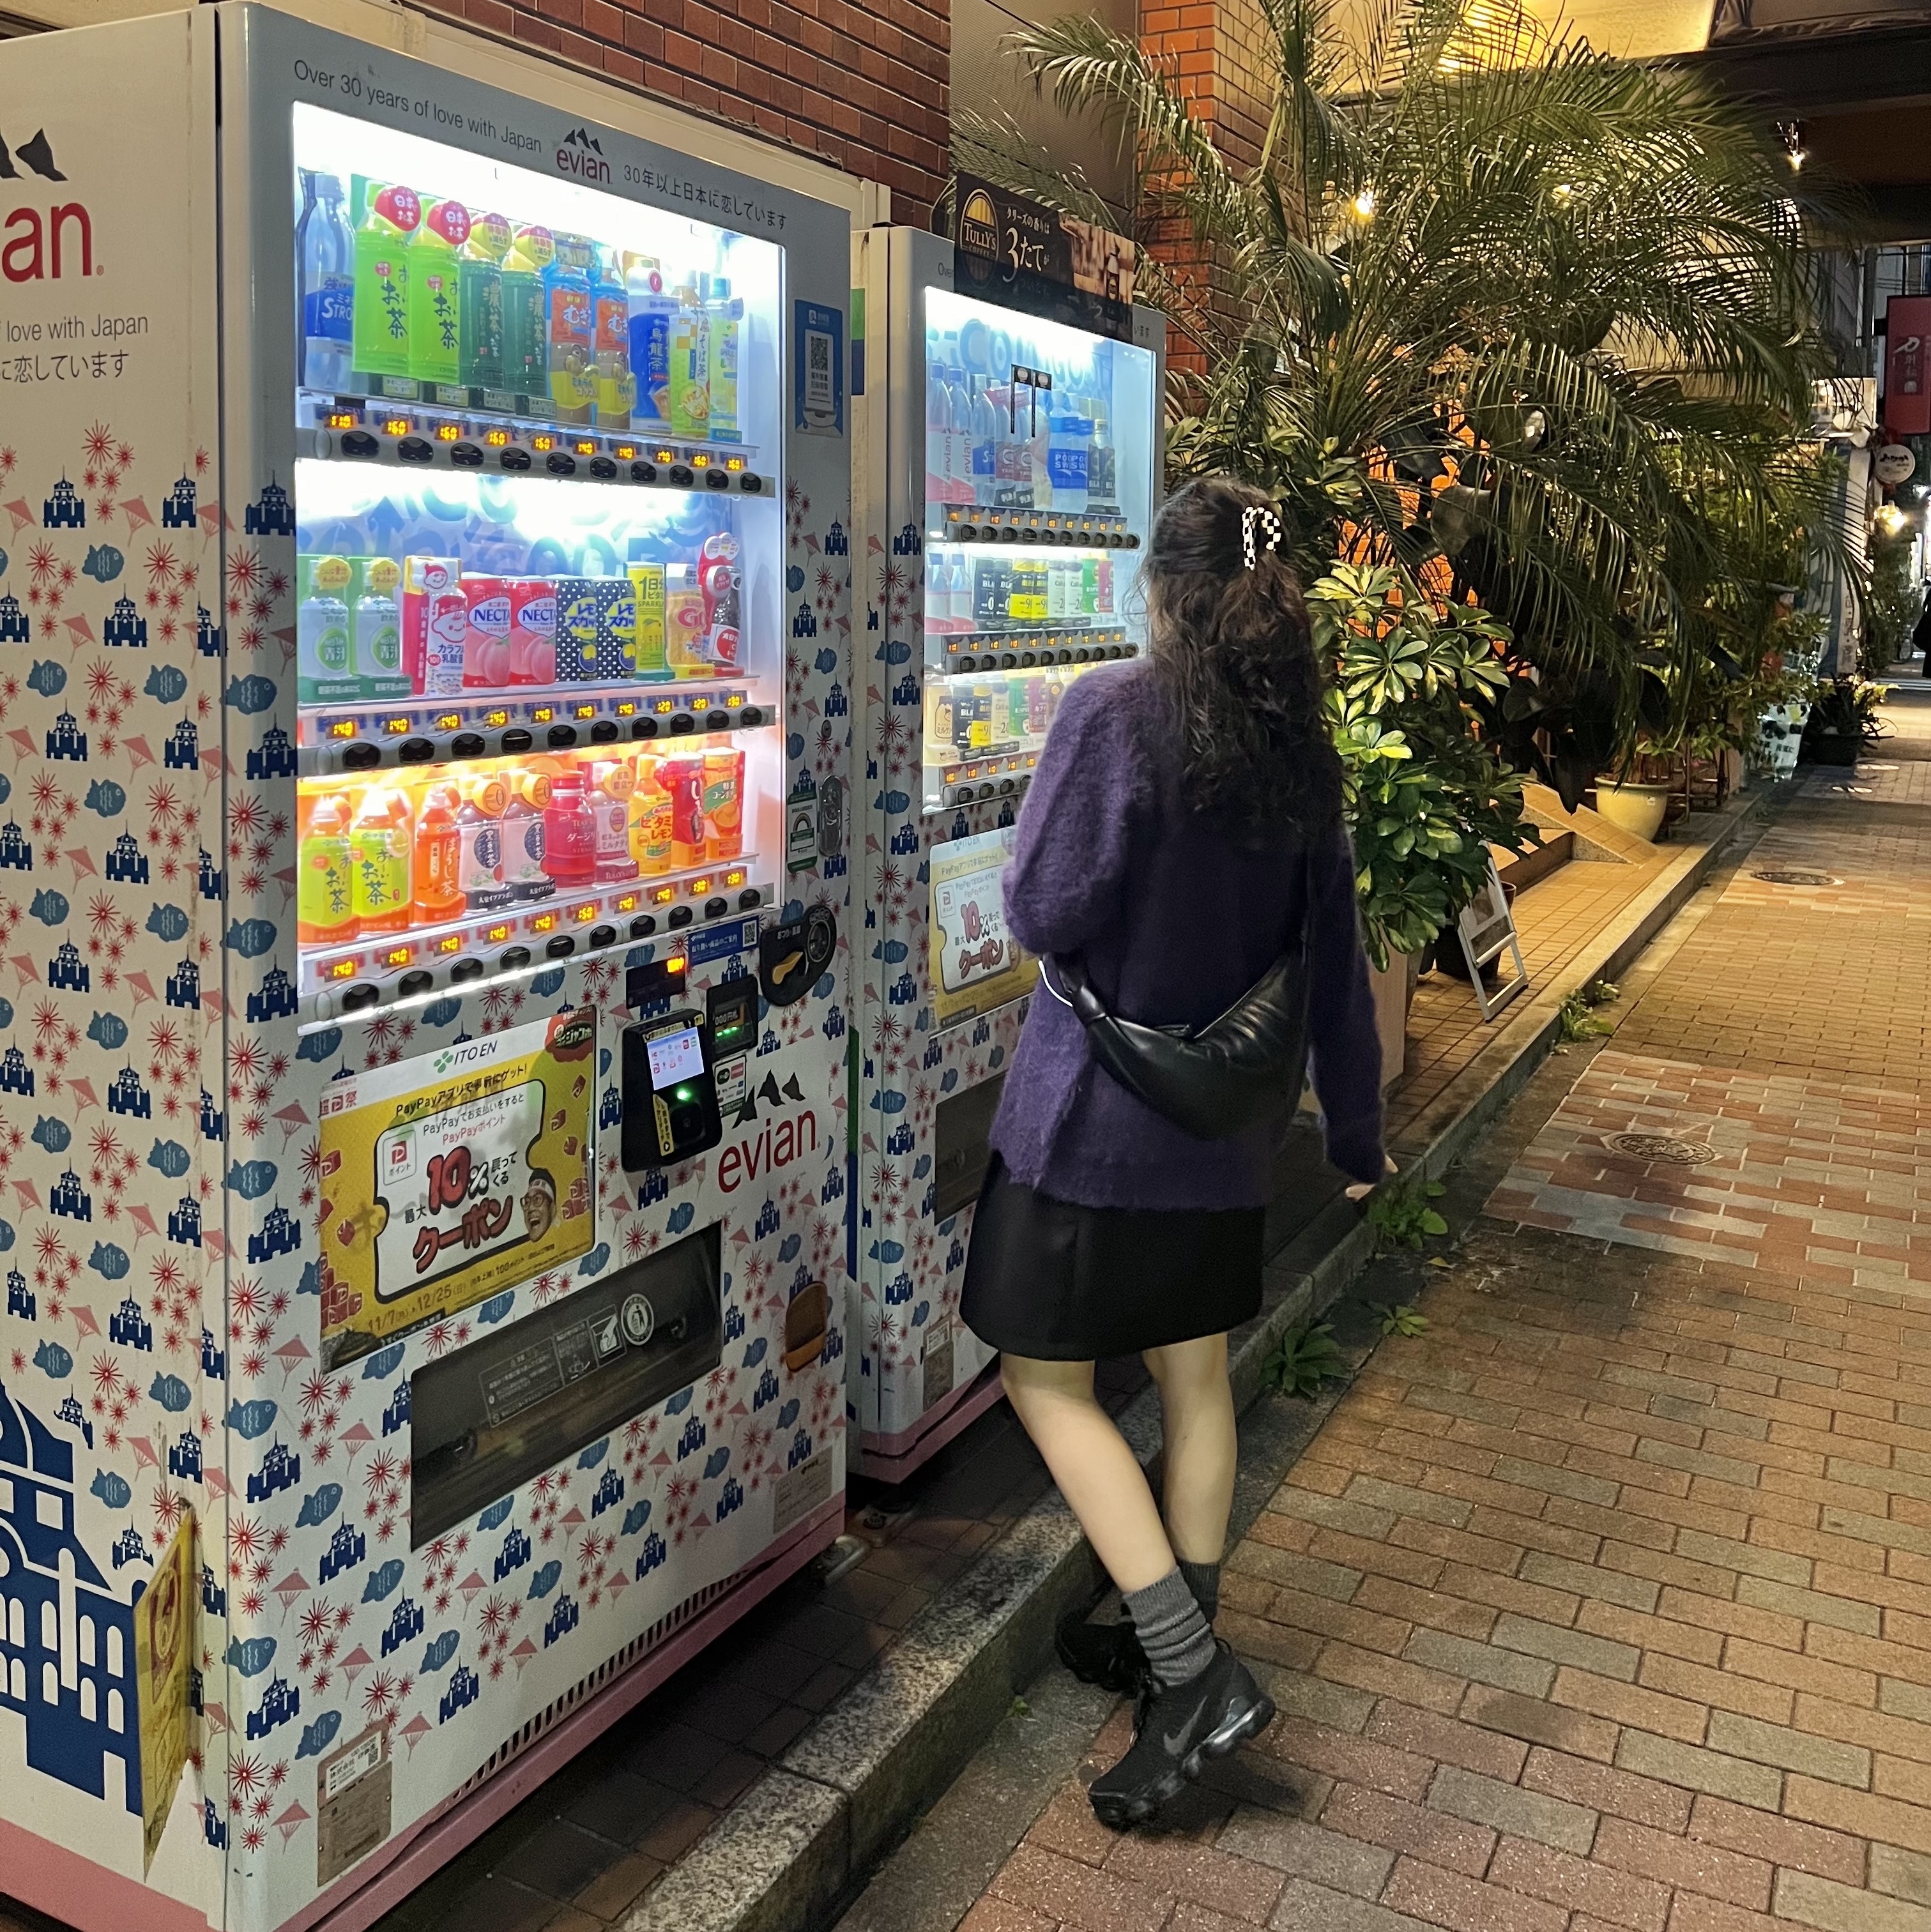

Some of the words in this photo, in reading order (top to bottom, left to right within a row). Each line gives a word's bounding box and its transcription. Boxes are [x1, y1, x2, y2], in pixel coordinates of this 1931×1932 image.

[294, 59, 335, 89] Over
[340, 74, 362, 96] 30
[367, 85, 409, 112] years
[415, 100, 431, 118] of
[434, 103, 463, 128] love
[468, 117, 496, 139] with
[501, 126, 542, 153] Japan
[556, 148, 611, 185] evian
[623, 165, 787, 230] 30年以上日本に恋しています
[963, 222, 996, 250] TULLY'S
[7, 321, 42, 342] love
[48, 316, 85, 340] with
[91, 313, 149, 341] Japan
[648, 328, 664, 371] 烏龍茶
[962, 437, 972, 474] evian
[324, 646, 346, 661] 青汁
[489, 711, 505, 724] 140
[535, 708, 550, 720] 140
[658, 701, 671, 711] 120
[389, 719, 408, 732] 140
[441, 715, 458, 727] 140
[441, 836, 460, 897] ほうじ茶
[325, 866, 350, 915] お茶
[361, 859, 392, 906] お茶
[490, 925, 506, 939] 140
[535, 915, 551, 929] 140
[960, 901, 990, 944] 10%
[389, 948, 408, 963] 140
[441, 937, 458, 951] 140
[333, 961, 353, 976] 140
[958, 938, 1004, 980] クーポン
[454, 1046, 478, 1065] ITO
[480, 1040, 498, 1057] EN
[442, 1114, 507, 1146] PayPayポイント
[718, 1110, 816, 1194] evian
[427, 1145, 489, 1215] 10%
[492, 1170, 509, 1187] くる
[412, 1194, 514, 1274] クーポン
